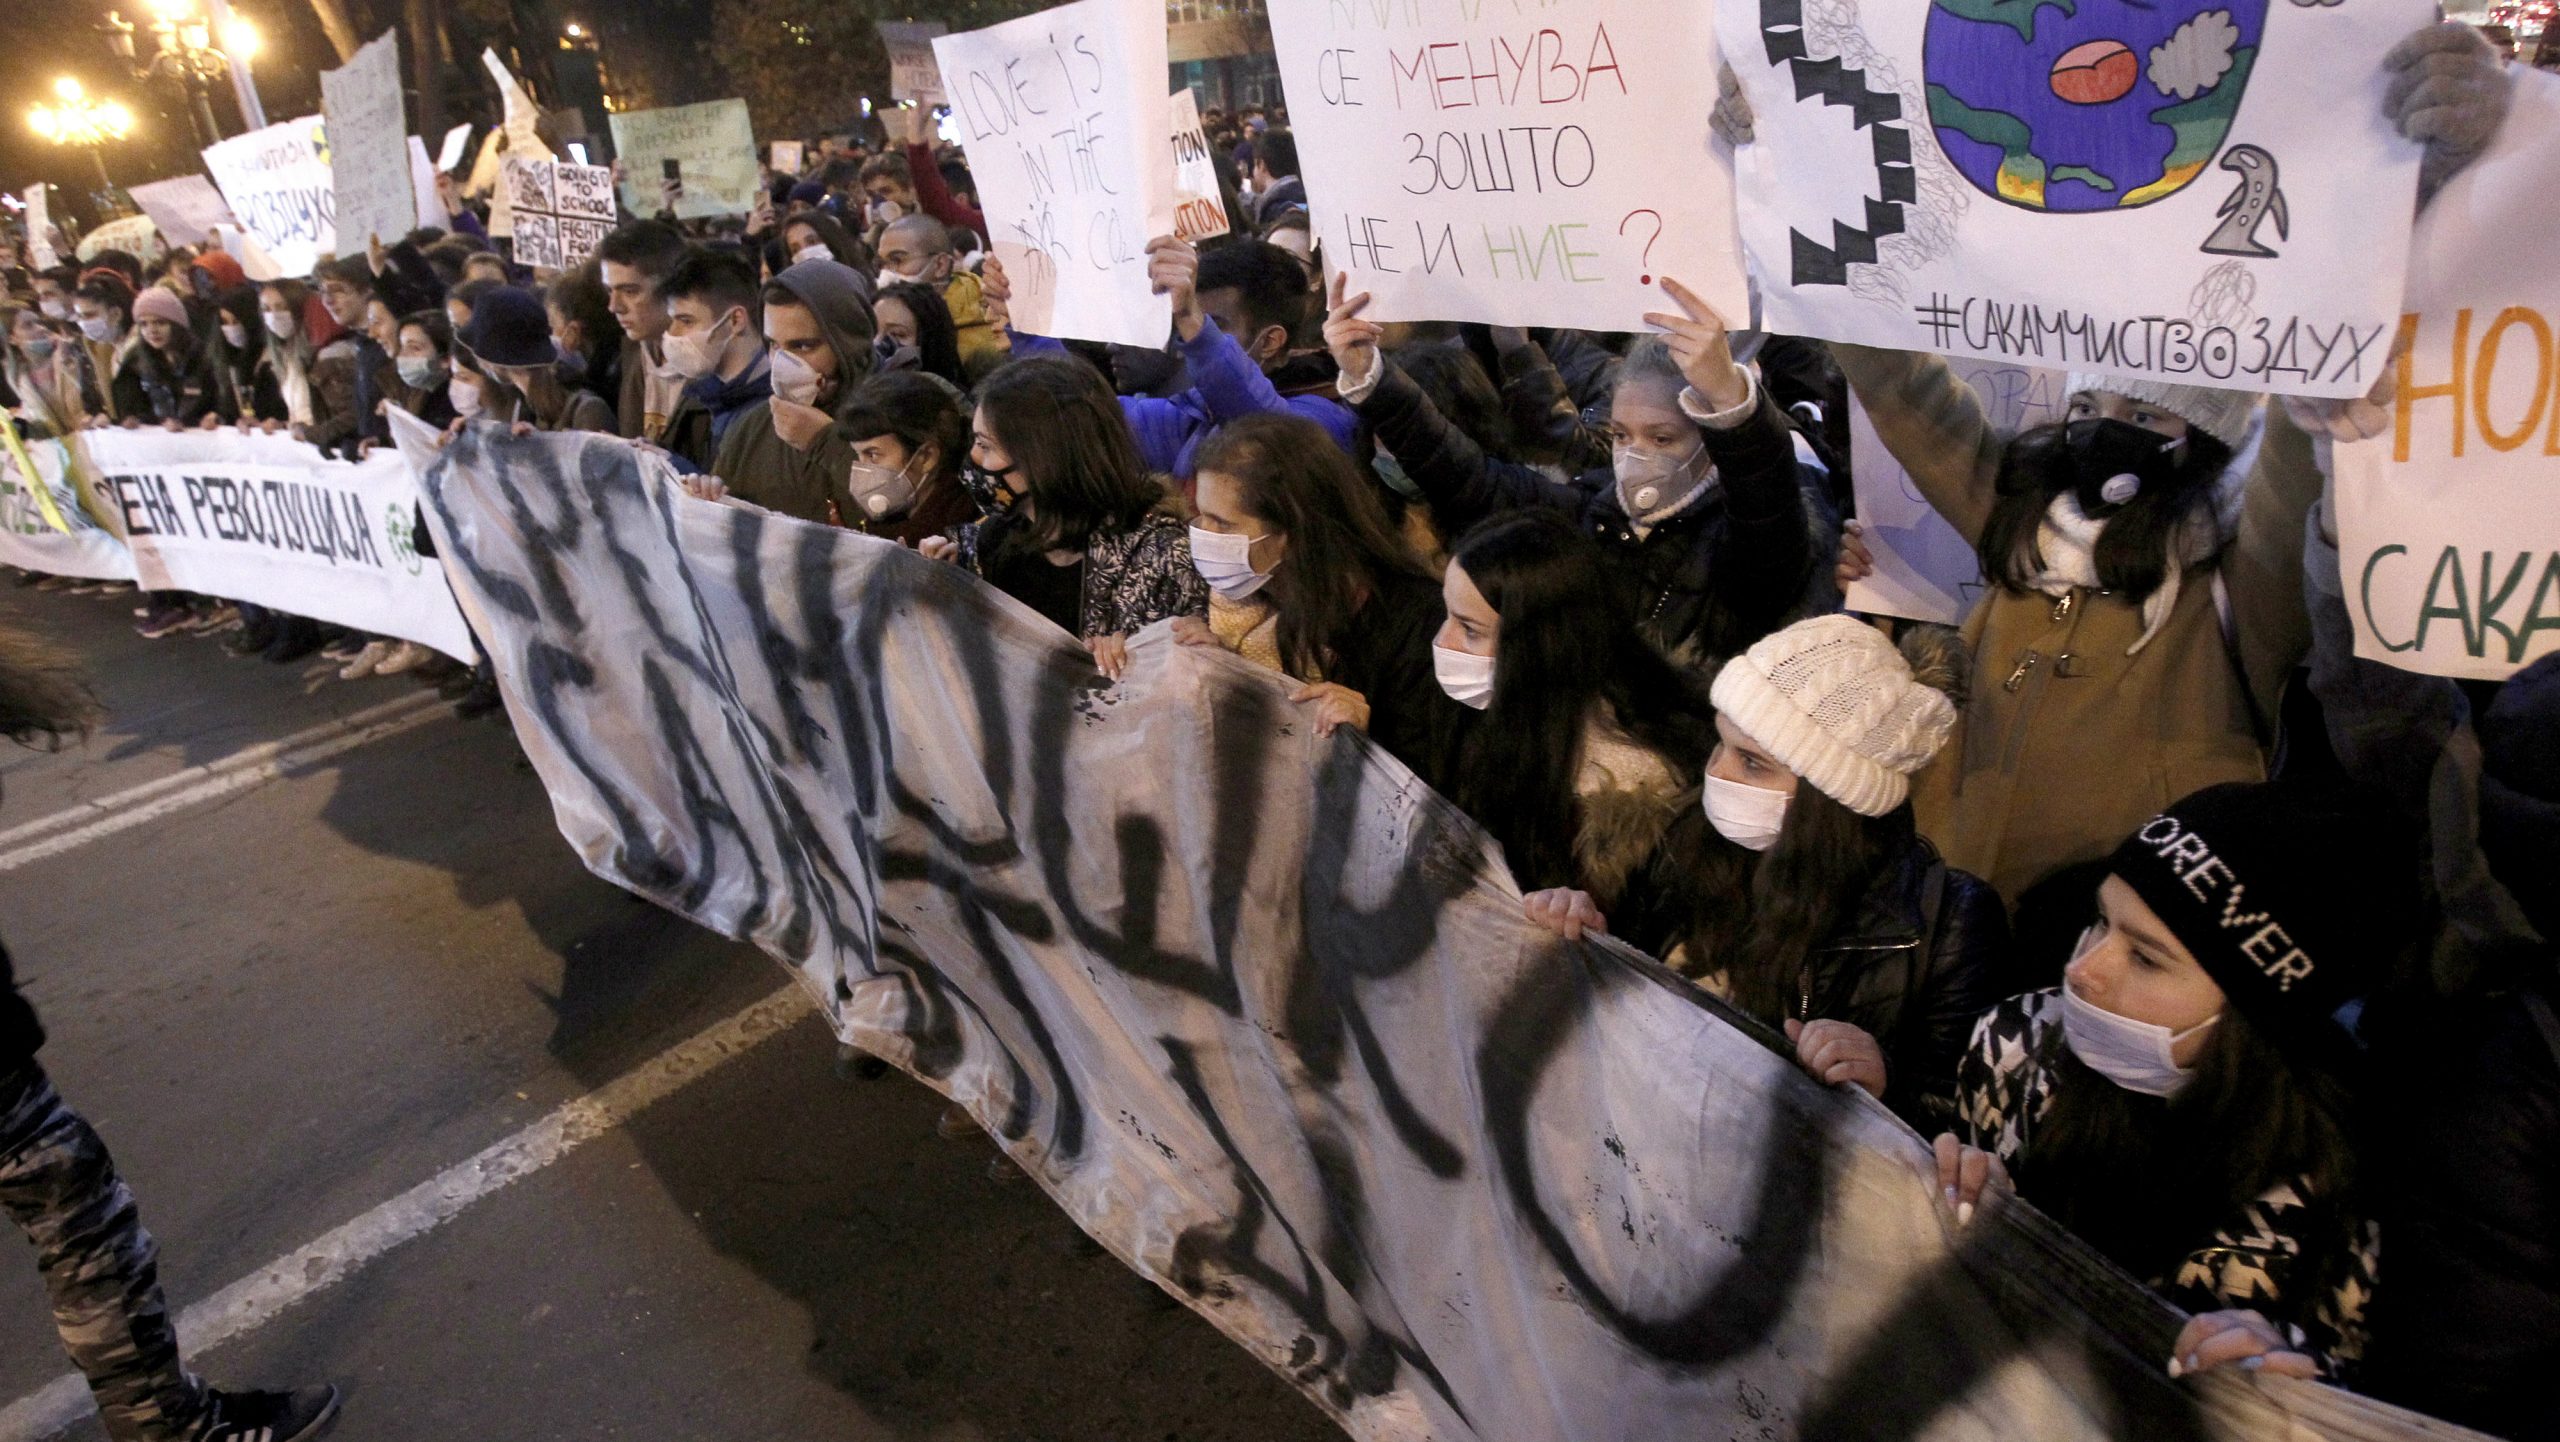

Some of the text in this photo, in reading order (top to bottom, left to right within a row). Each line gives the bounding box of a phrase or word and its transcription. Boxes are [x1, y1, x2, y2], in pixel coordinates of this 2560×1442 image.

[947, 57, 1048, 141] LOVE
[1319, 21, 1627, 110] СЕ МЕНУВА
[573, 181, 593, 198] TO
[1051, 111, 1120, 195] THE
[1402, 125, 1595, 195] ЗОШТО
[561, 194, 615, 218] SCHOOL
[1344, 212, 1401, 275] НЕ
[1416, 220, 1464, 278] И
[1481, 223, 1605, 284] НИЕ
[183, 475, 384, 569] РЕВОЛУЦИЈА
[2138, 813, 2316, 992] OREVER
